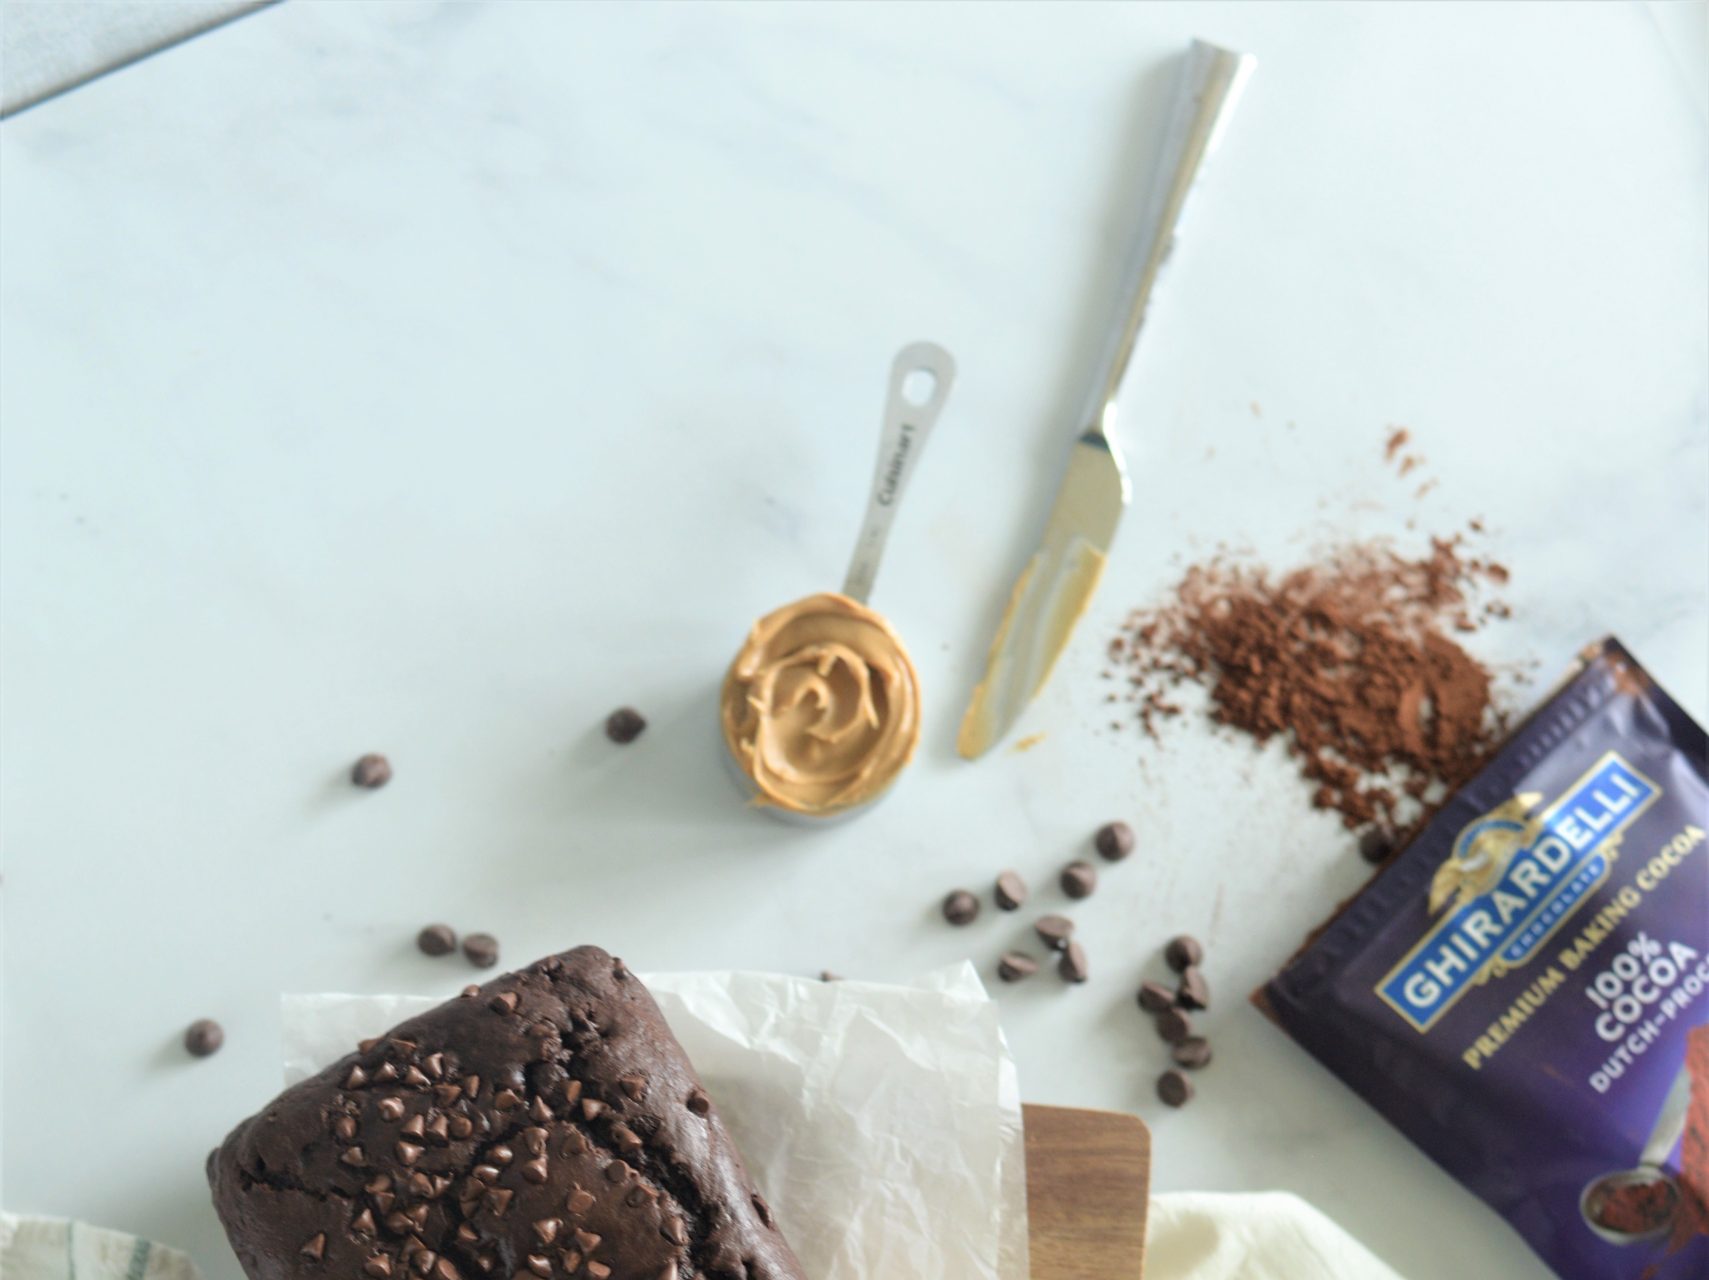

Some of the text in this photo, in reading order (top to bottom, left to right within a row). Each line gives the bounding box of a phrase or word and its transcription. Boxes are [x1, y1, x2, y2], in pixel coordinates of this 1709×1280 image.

[1403, 773, 1640, 1008] GHIRARDELLI
[1462, 824, 1706, 1070] PREMIUM BAKING COCOA
[1585, 931, 1662, 1010] 100%
[1589, 952, 1709, 1094] DUTCH-PROC
[1595, 941, 1698, 1042] COCOA
